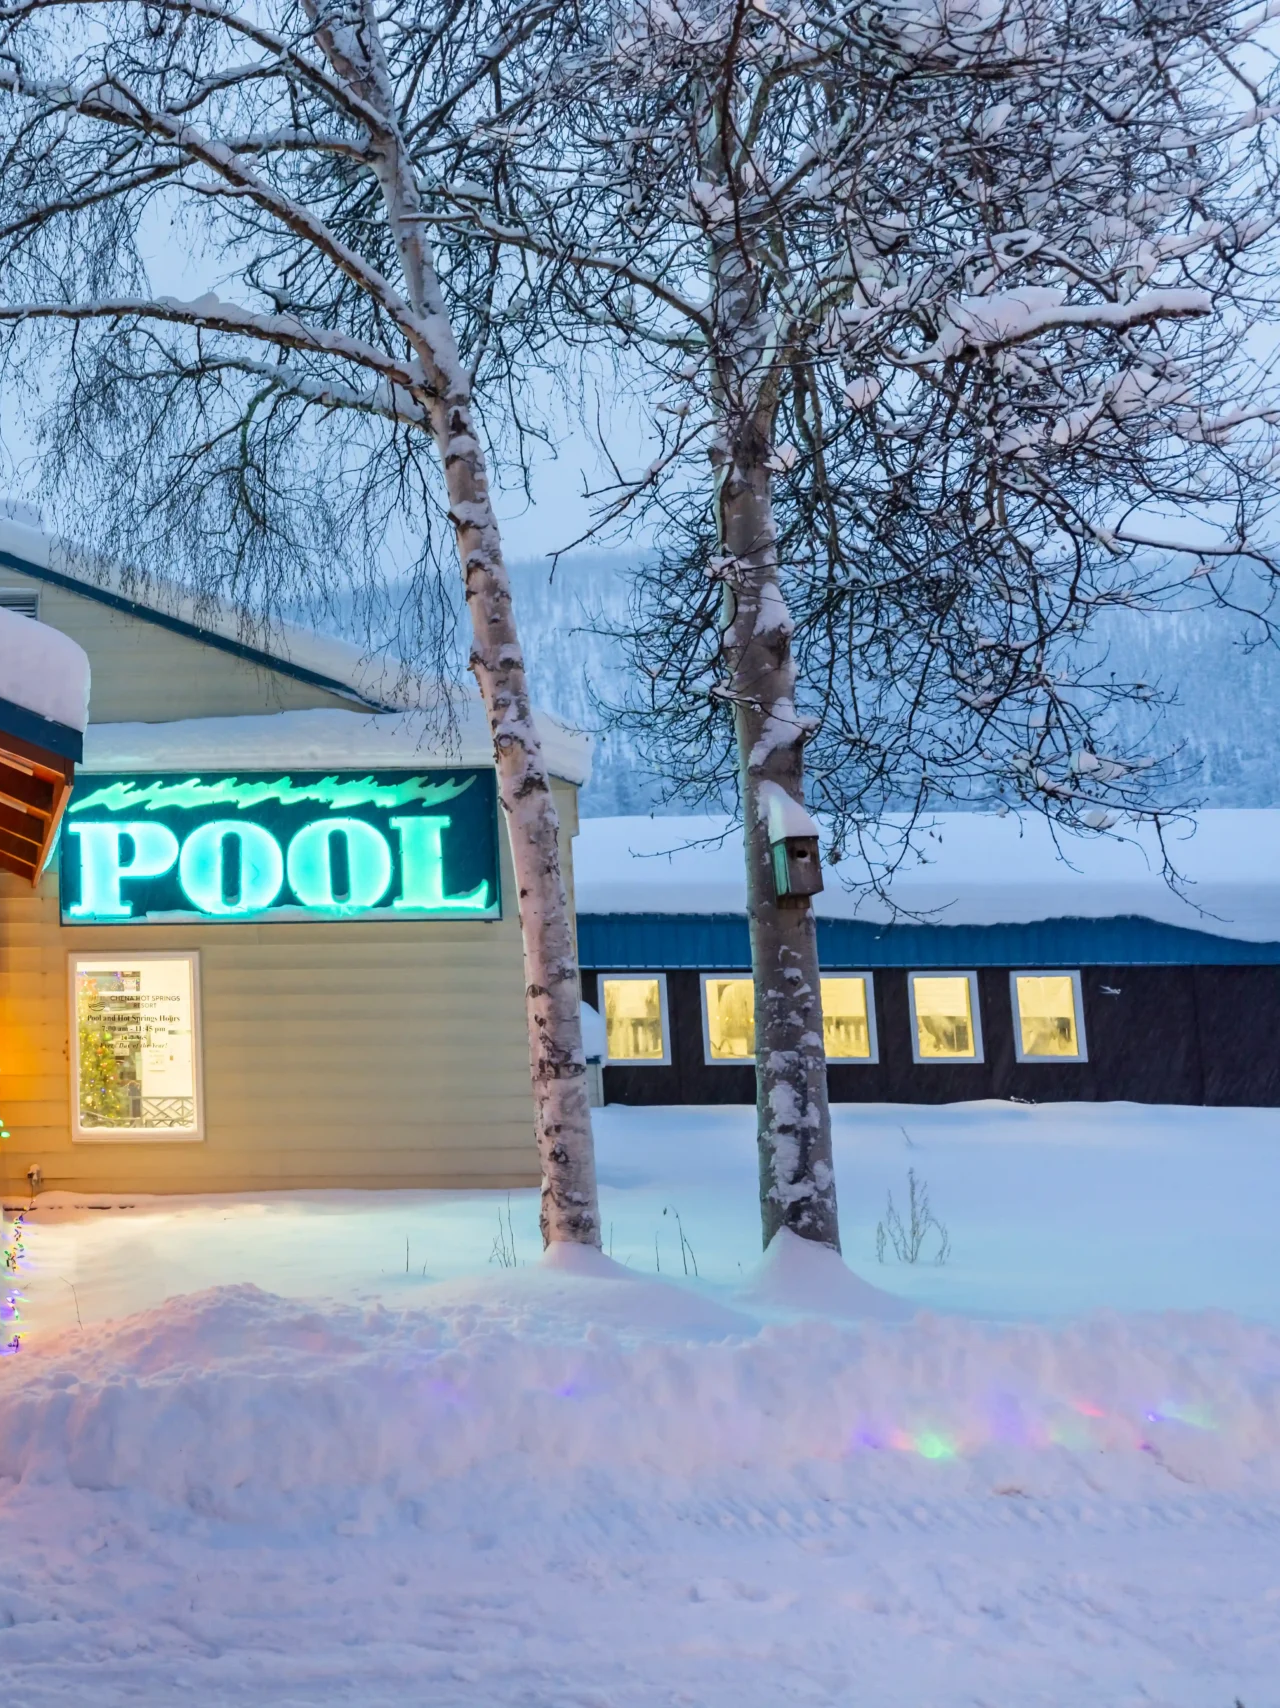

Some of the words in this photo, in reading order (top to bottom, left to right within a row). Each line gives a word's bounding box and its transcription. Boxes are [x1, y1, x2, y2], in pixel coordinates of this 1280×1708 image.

[69, 816, 489, 918] POOL
[87, 1014, 101, 1022] Pool
[103, 1014, 116, 1022] and
[117, 1014, 130, 1022] Hot
[131, 1014, 158, 1023] Springs
[159, 1014, 181, 1022] Hours
[154, 1026, 166, 1034] pm
